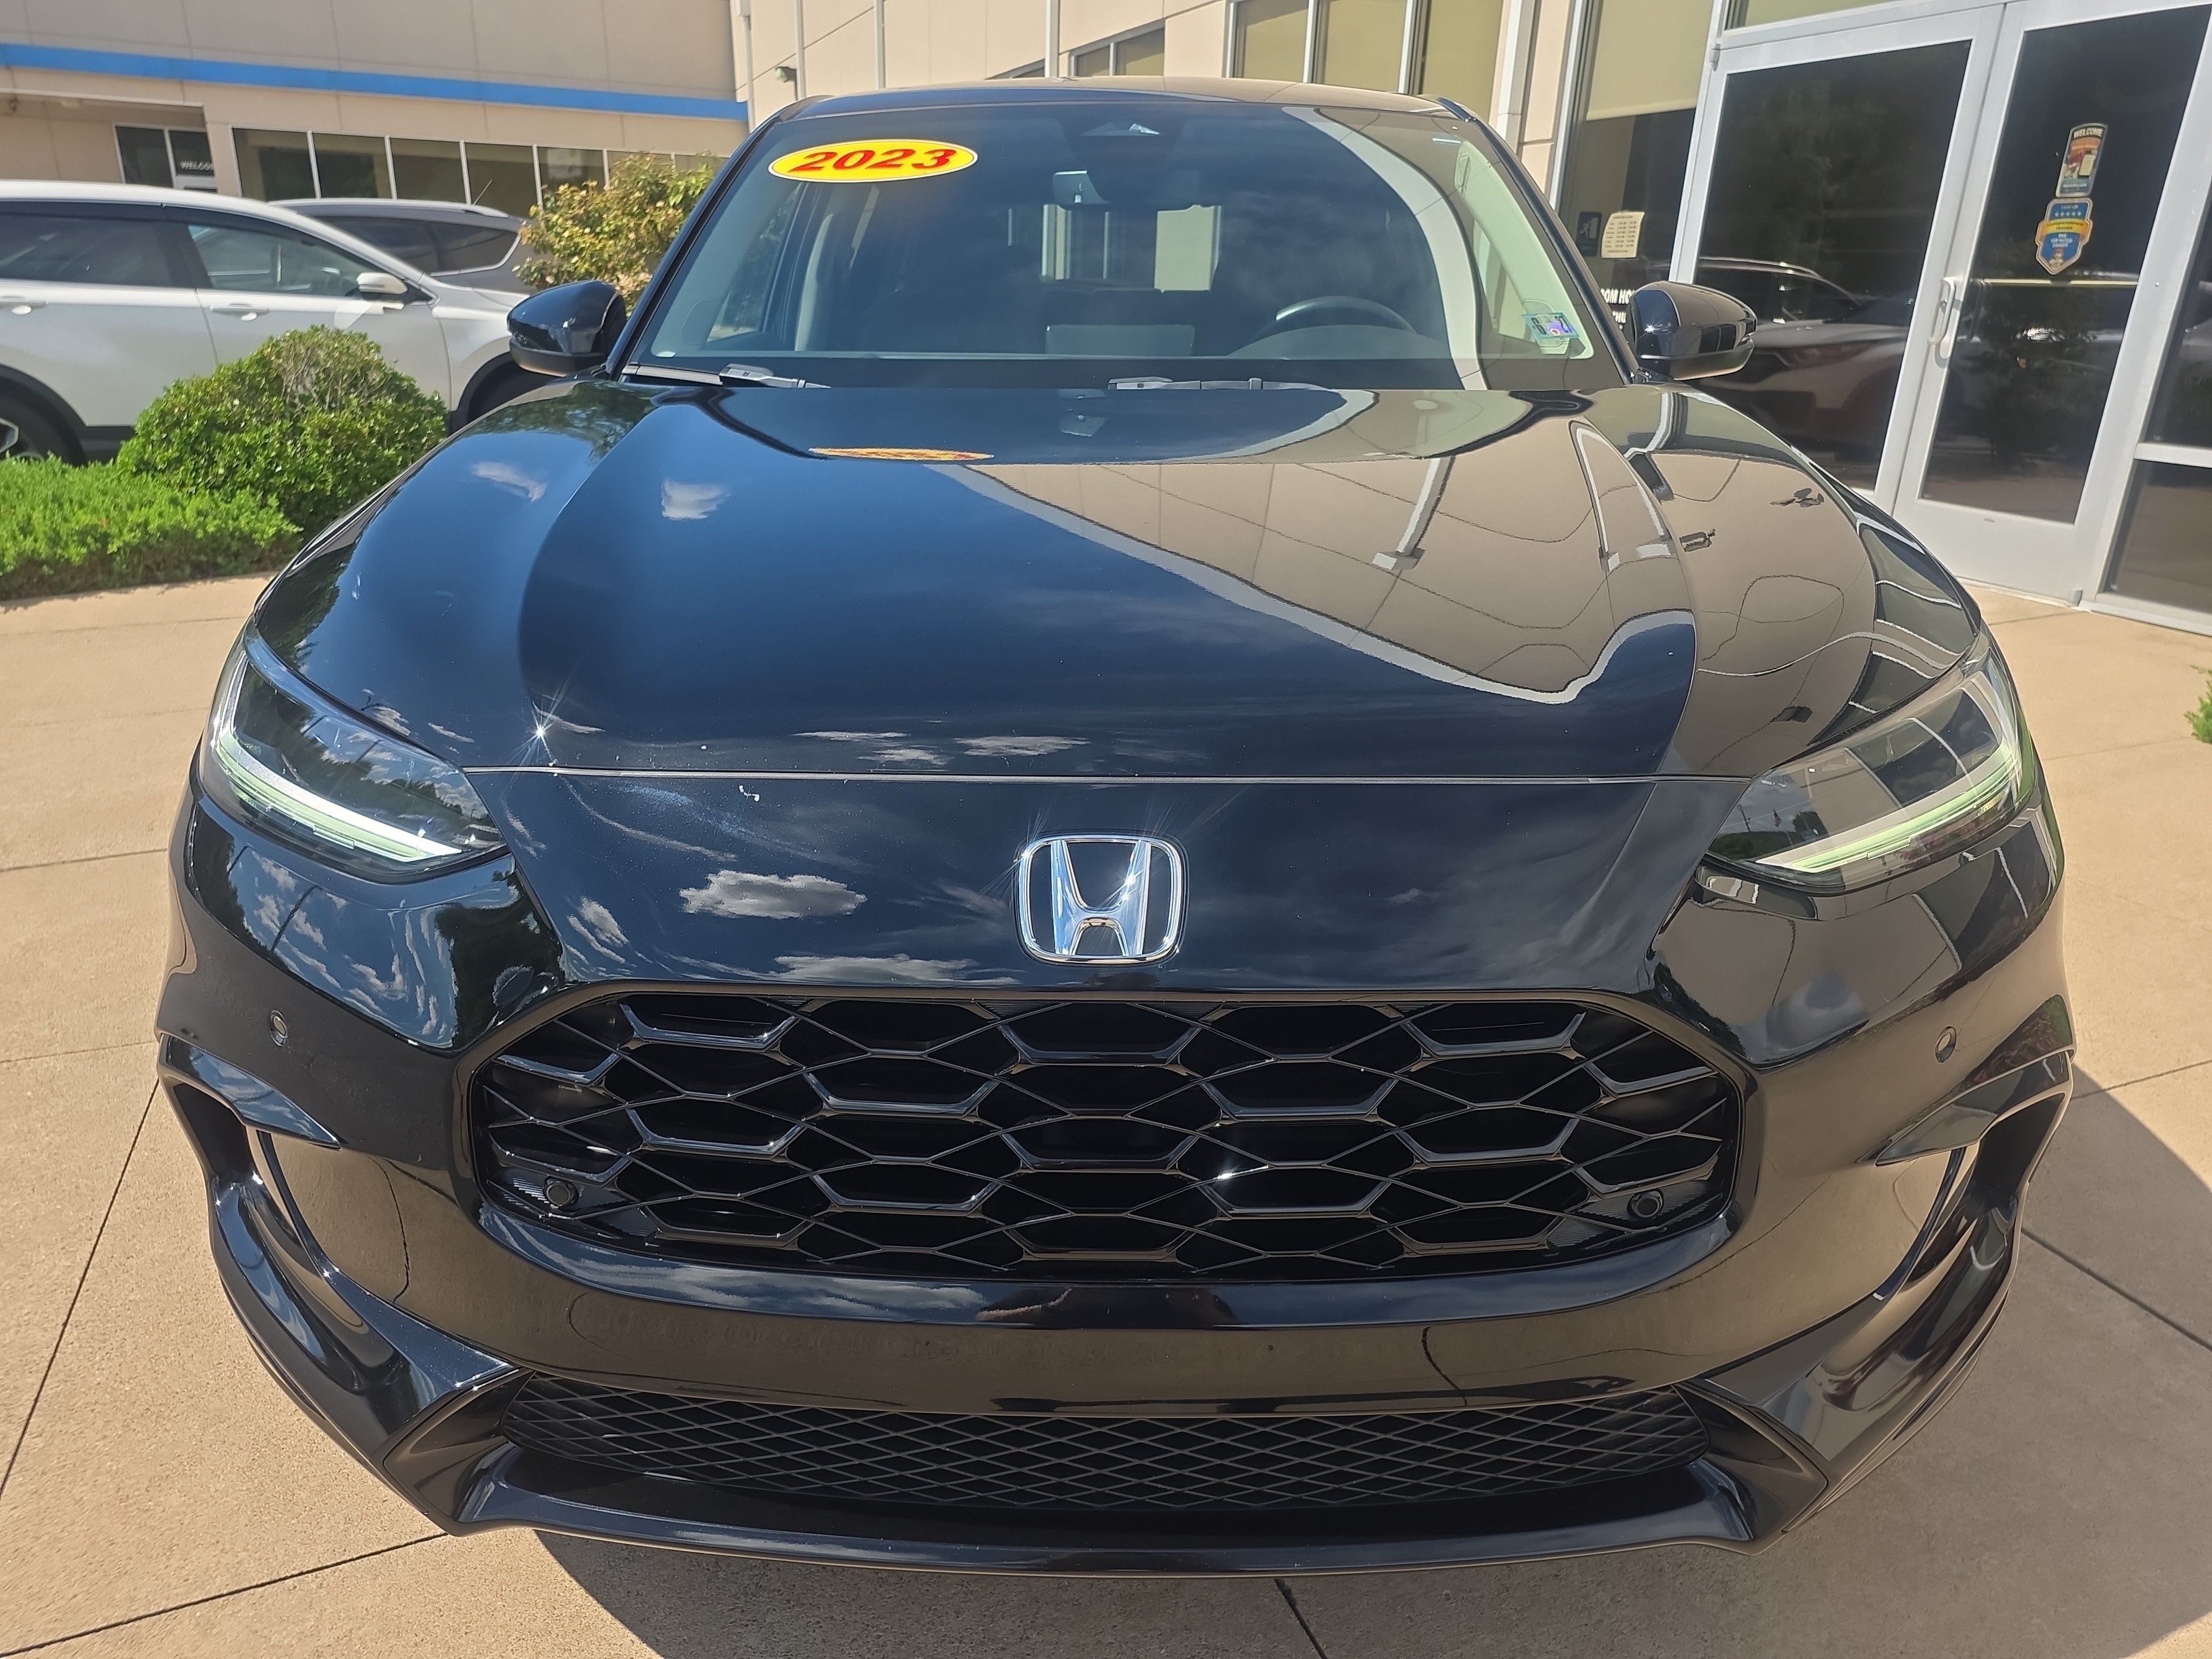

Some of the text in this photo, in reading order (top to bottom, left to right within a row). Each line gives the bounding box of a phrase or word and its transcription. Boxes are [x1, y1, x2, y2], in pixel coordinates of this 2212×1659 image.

[2074, 127, 2103, 139] WELCOME
[181, 161, 213, 170] WELCO
[788, 149, 957, 172] 2023
